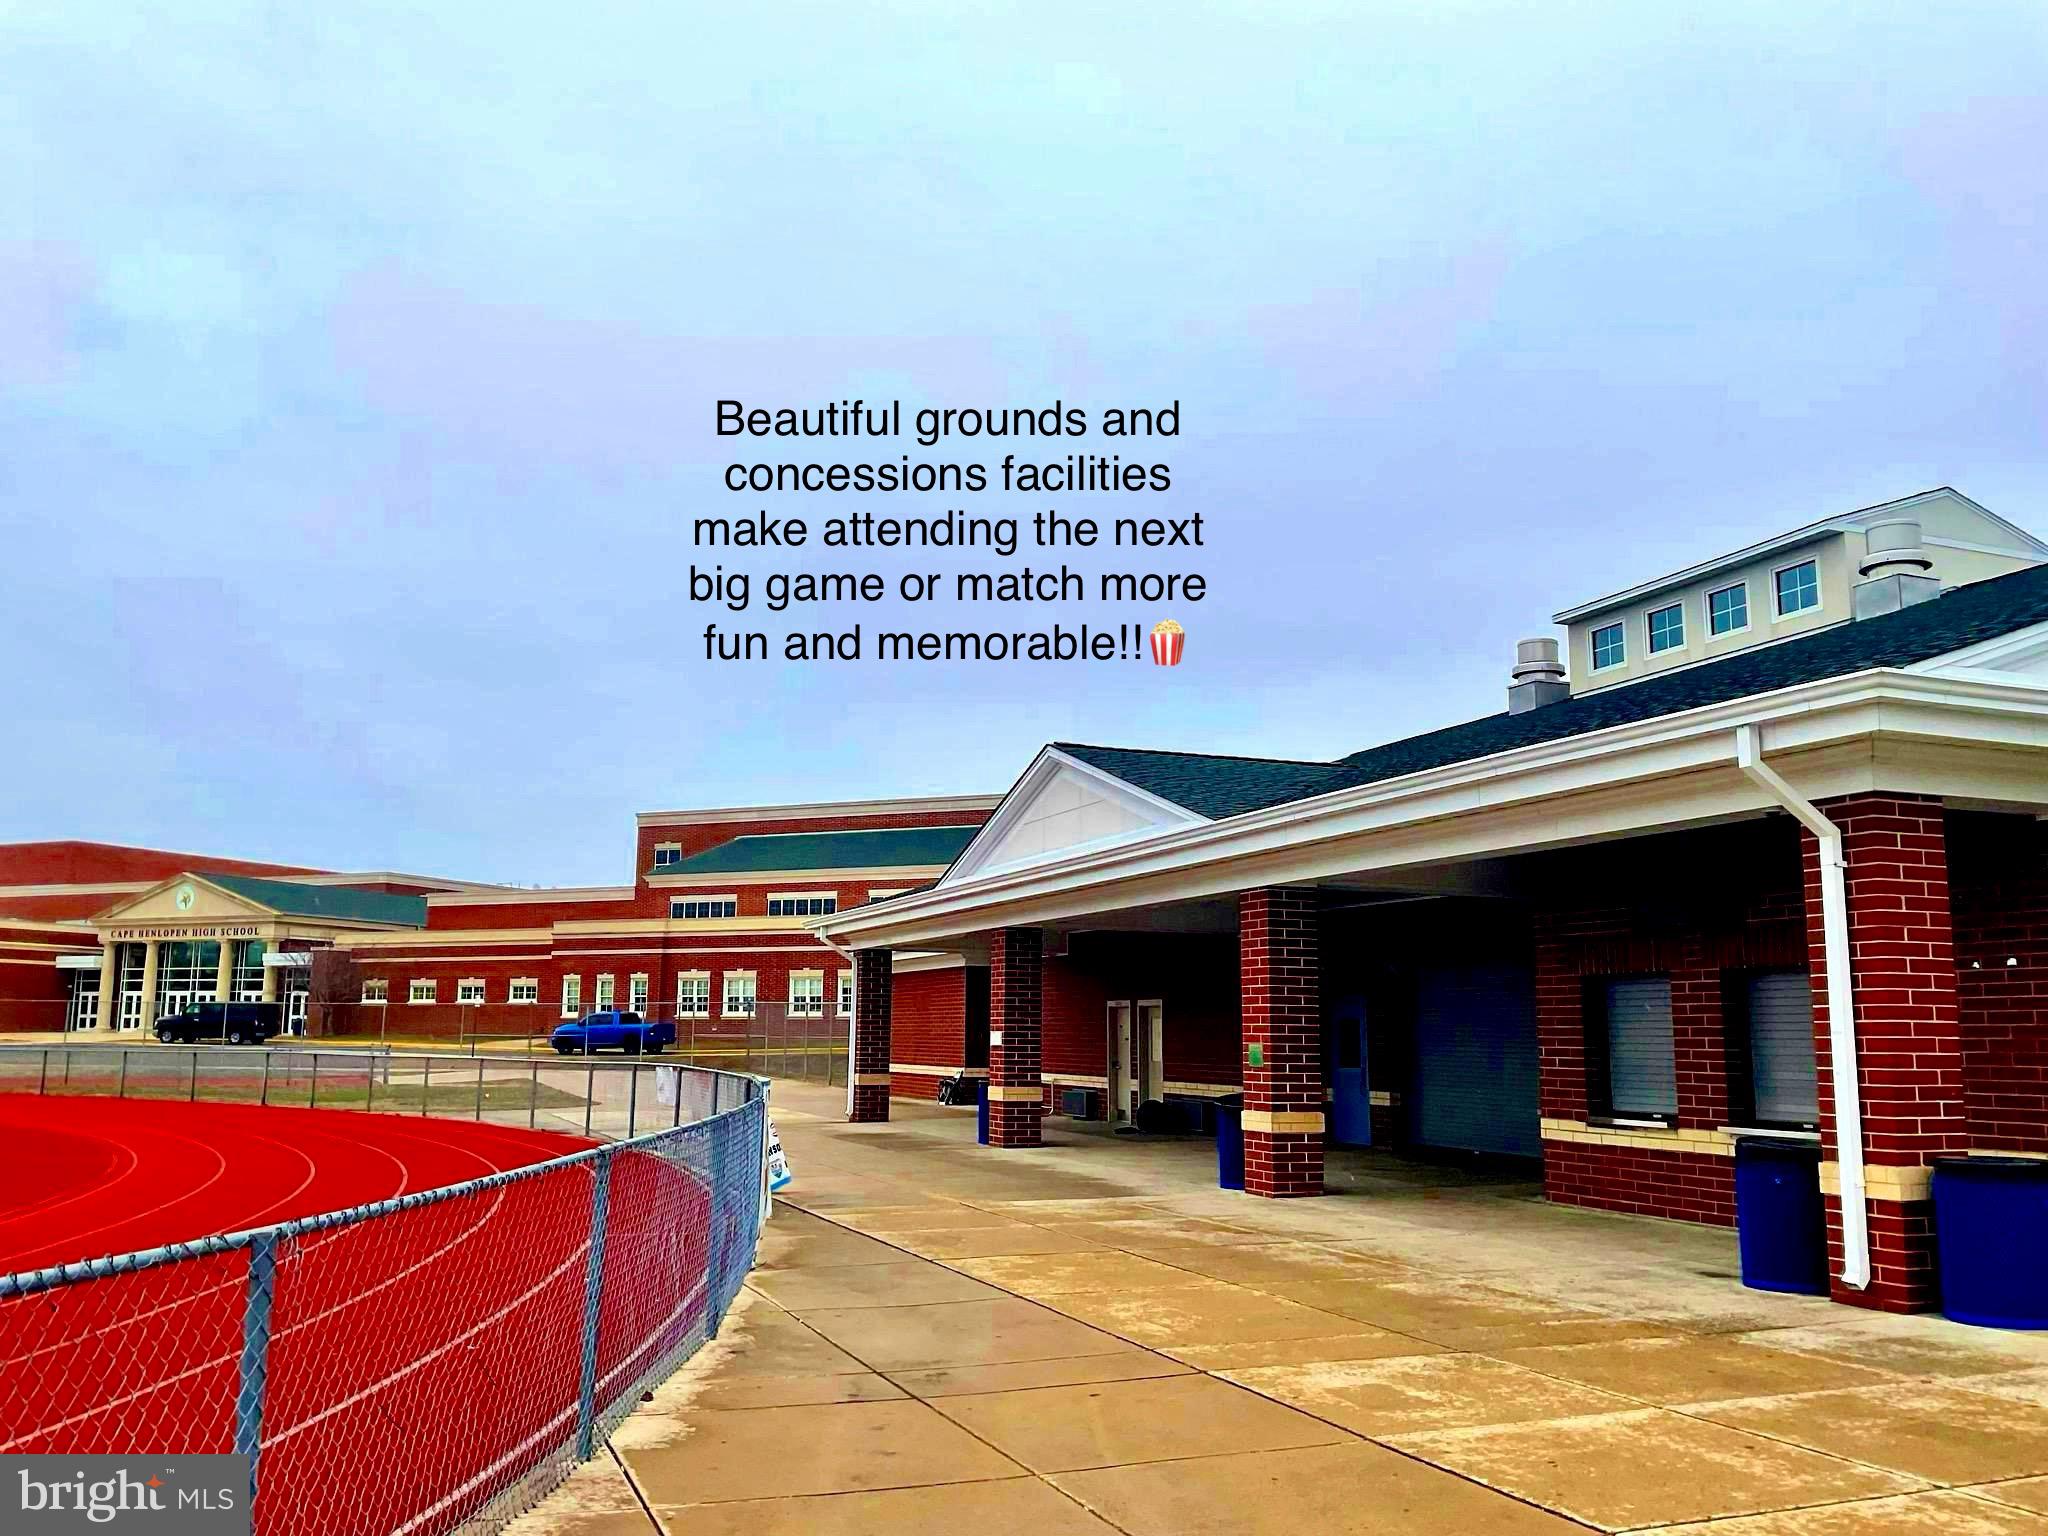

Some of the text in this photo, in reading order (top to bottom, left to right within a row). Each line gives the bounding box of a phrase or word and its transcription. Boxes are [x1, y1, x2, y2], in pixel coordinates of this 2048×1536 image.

[110, 927, 260, 938] CAPE HENLOPEN HIGH SCHOOL
